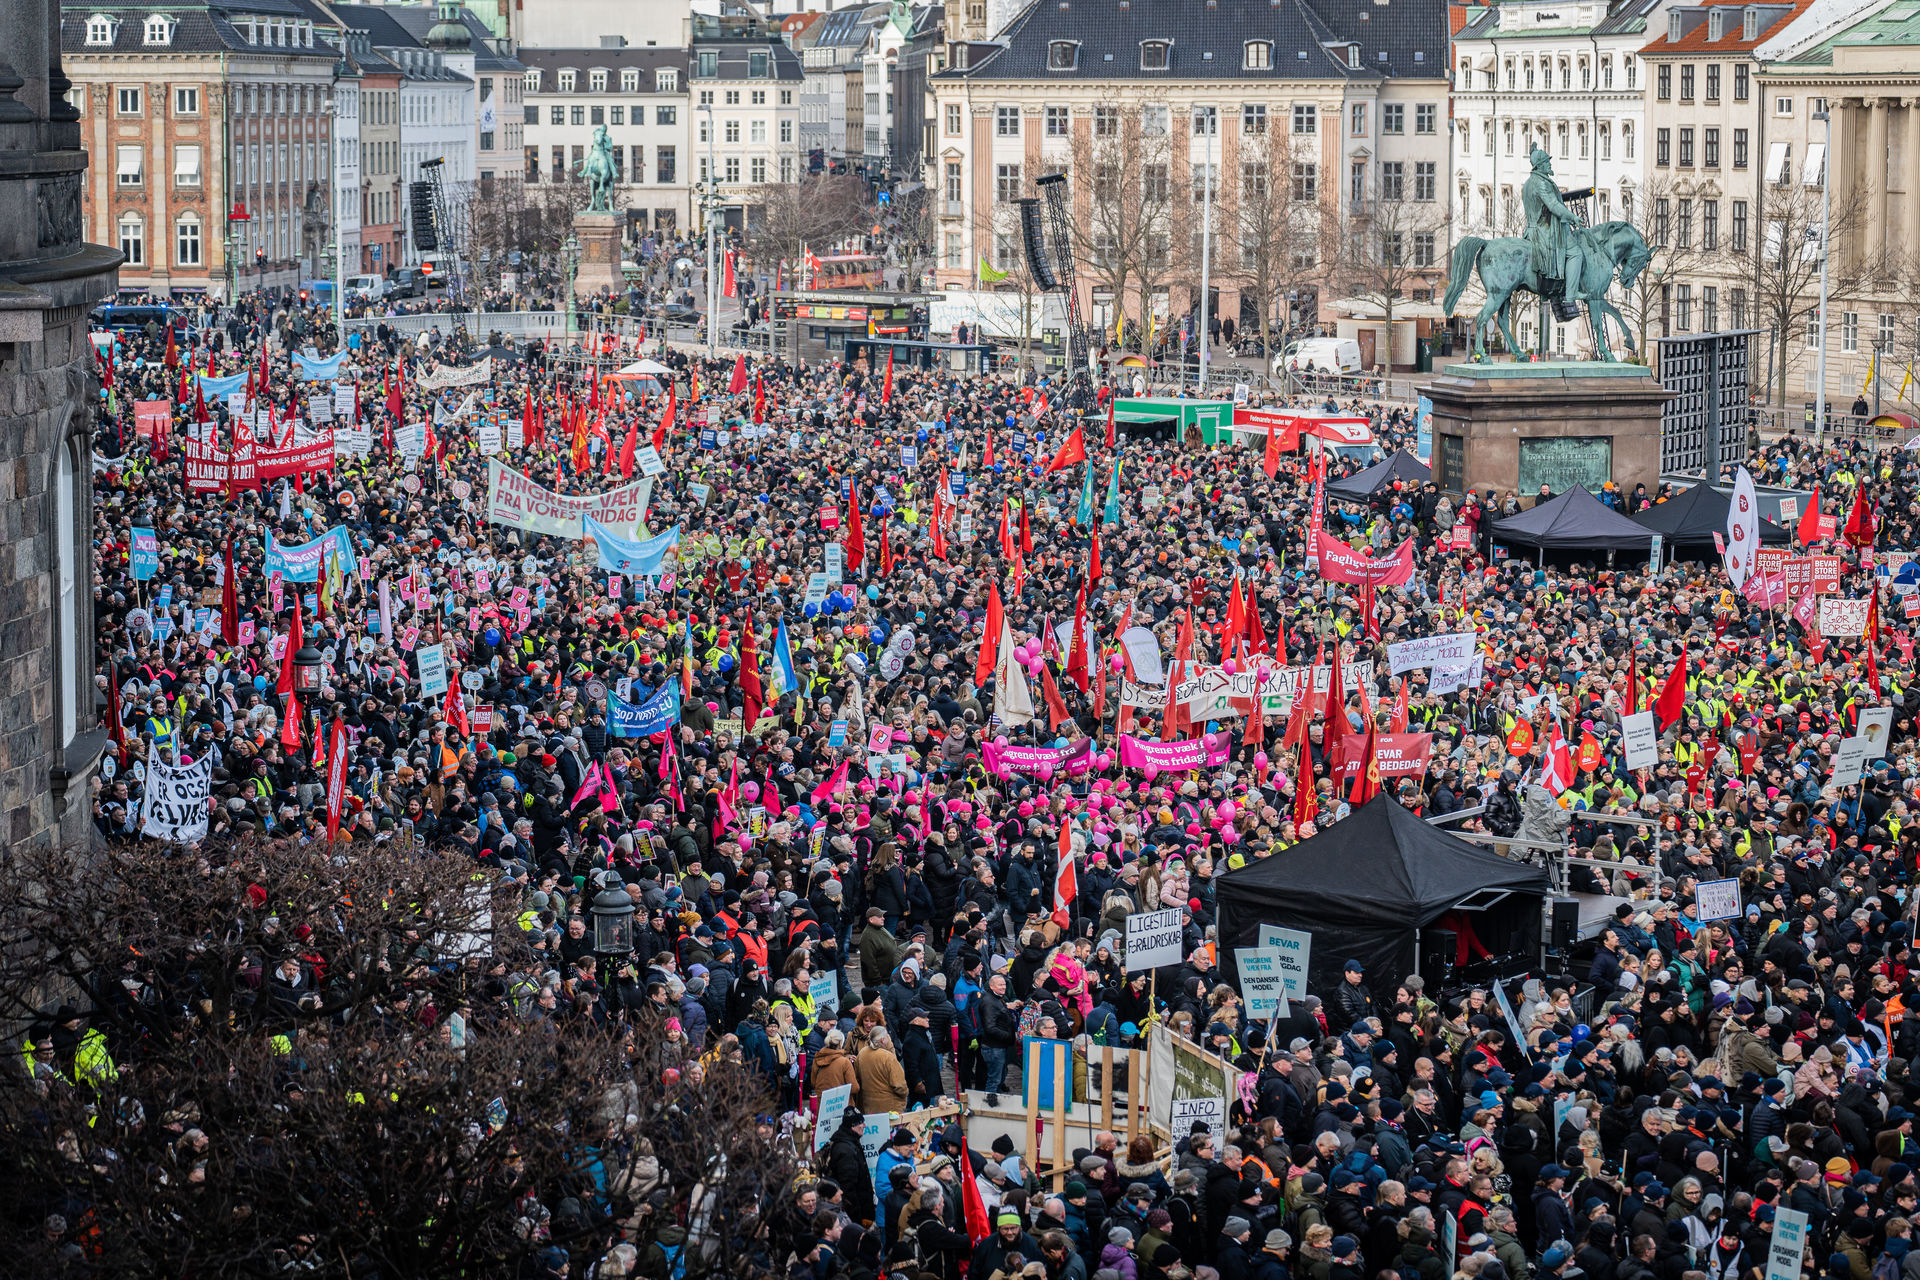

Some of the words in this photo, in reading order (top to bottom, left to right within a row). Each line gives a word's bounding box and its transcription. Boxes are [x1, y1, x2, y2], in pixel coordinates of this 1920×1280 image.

[233, 203, 246, 215] M
[186, 441, 200, 459] VIL
[201, 444, 213, 460] DE
[290, 454, 301, 463] ER
[300, 450, 317, 461] IKKE
[317, 446, 334, 457] NOK!
[186, 461, 198, 478] SÅ
[198, 464, 214, 480] LAD
[240, 463, 256, 479] DET!
[498, 468, 593, 510] FINGRENE
[599, 486, 641, 508] VÆK
[496, 489, 522, 511] FRA
[526, 499, 577, 521] VORES
[581, 507, 637, 523] FRIDAG
[267, 554, 282, 567] FOR
[1325, 550, 1366, 569] Faglige
[1757, 553, 1781, 561] BEVAR
[616, 559, 631, 570] 3F
[1801, 563, 1811, 571] VAR
[1826, 615, 1849, 624] GØR
[1857, 613, 1865, 622] VI
[1823, 623, 1865, 635] FORSKEL
[1400, 640, 1430, 653] BEVAR
[1435, 637, 1453, 648] DEN
[1393, 650, 1427, 668] DANSKE
[1437, 646, 1465, 660] MODEL
[614, 707, 634, 723] Stop
[1002, 750, 1035, 761] ngrene
[1035, 751, 1059, 760] væk
[1059, 746, 1077, 758] fra
[1134, 740, 1172, 755] Fingrene
[1174, 743, 1198, 753] væk
[1071, 759, 1088, 768] BUPL
[1146, 754, 1170, 766] vores
[1170, 753, 1208, 766] fridag!
[1379, 758, 1422, 771] BEDEDAG
[158, 781, 171, 802] ER
[1129, 908, 1183, 934] LIGESTILLET
[1269, 936, 1300, 950] BEVAR
[1243, 956, 1272, 965] FINGRENE
[1246, 963, 1260, 972] VÆK
[810, 981, 832, 992] FINGRENE
[1243, 976, 1256, 984] DEN
[823, 988, 831, 996] FRA
[1251, 983, 1274, 991] MODEL
[825, 1095, 845, 1106] FINGRENE
[1179, 1101, 1215, 1115] INFO
[1779, 1220, 1801, 1233] FINGRENE
[1772, 1244, 1781, 1254] DEN
[1780, 1246, 1800, 1259] DANSKE
[1776, 1255, 1792, 1267] MODEL
